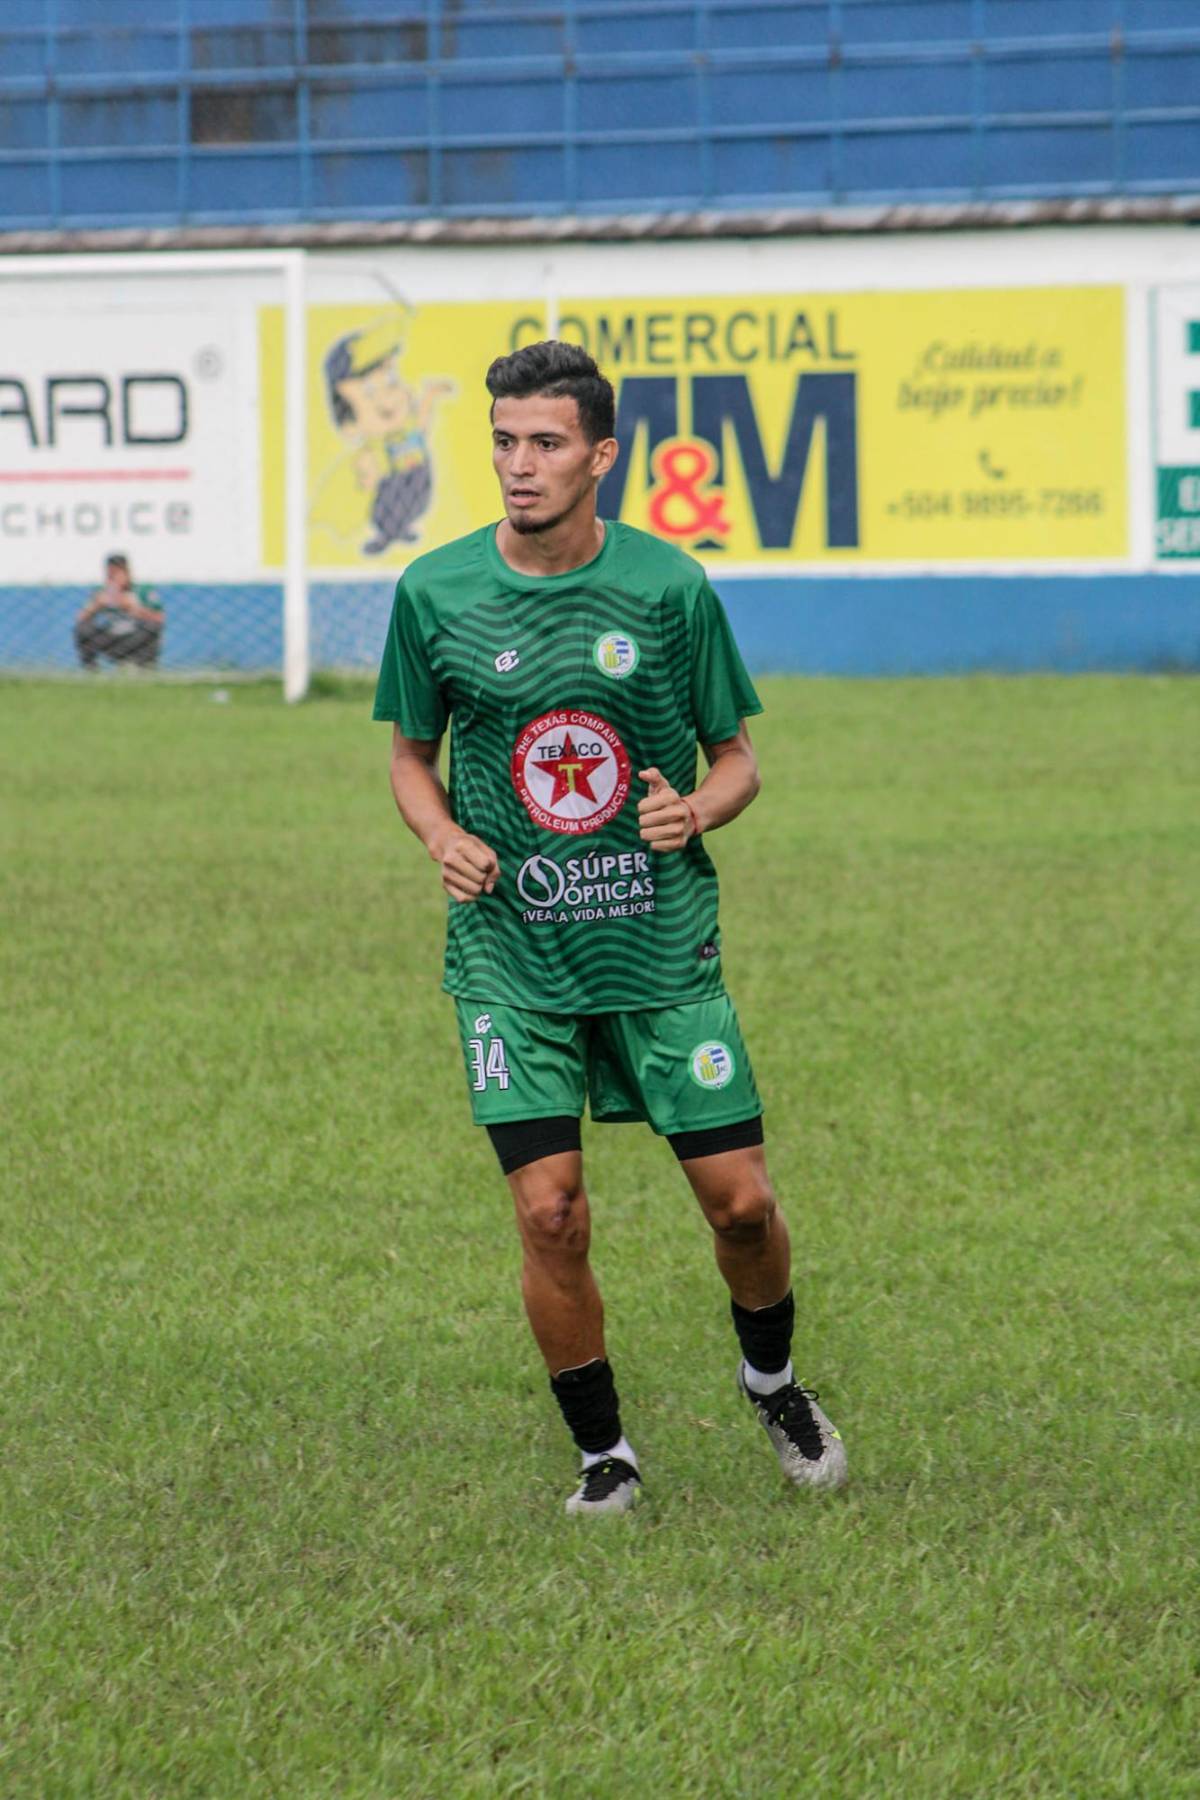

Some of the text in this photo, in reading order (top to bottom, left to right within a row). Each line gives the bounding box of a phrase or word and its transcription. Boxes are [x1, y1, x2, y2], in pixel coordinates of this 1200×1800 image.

[516, 713, 622, 756] THE TEXAS COMPANY
[537, 743, 602, 759] TEXACO
[520, 782, 628, 832] PETROLEUM PRODUCTS
[566, 851, 650, 881] SÚPER
[563, 876, 655, 906] ÓPTICAS
[522, 899, 655, 924] ¡VEA LA VIDA MEJOR!
[468, 1037, 509, 1092] 34
